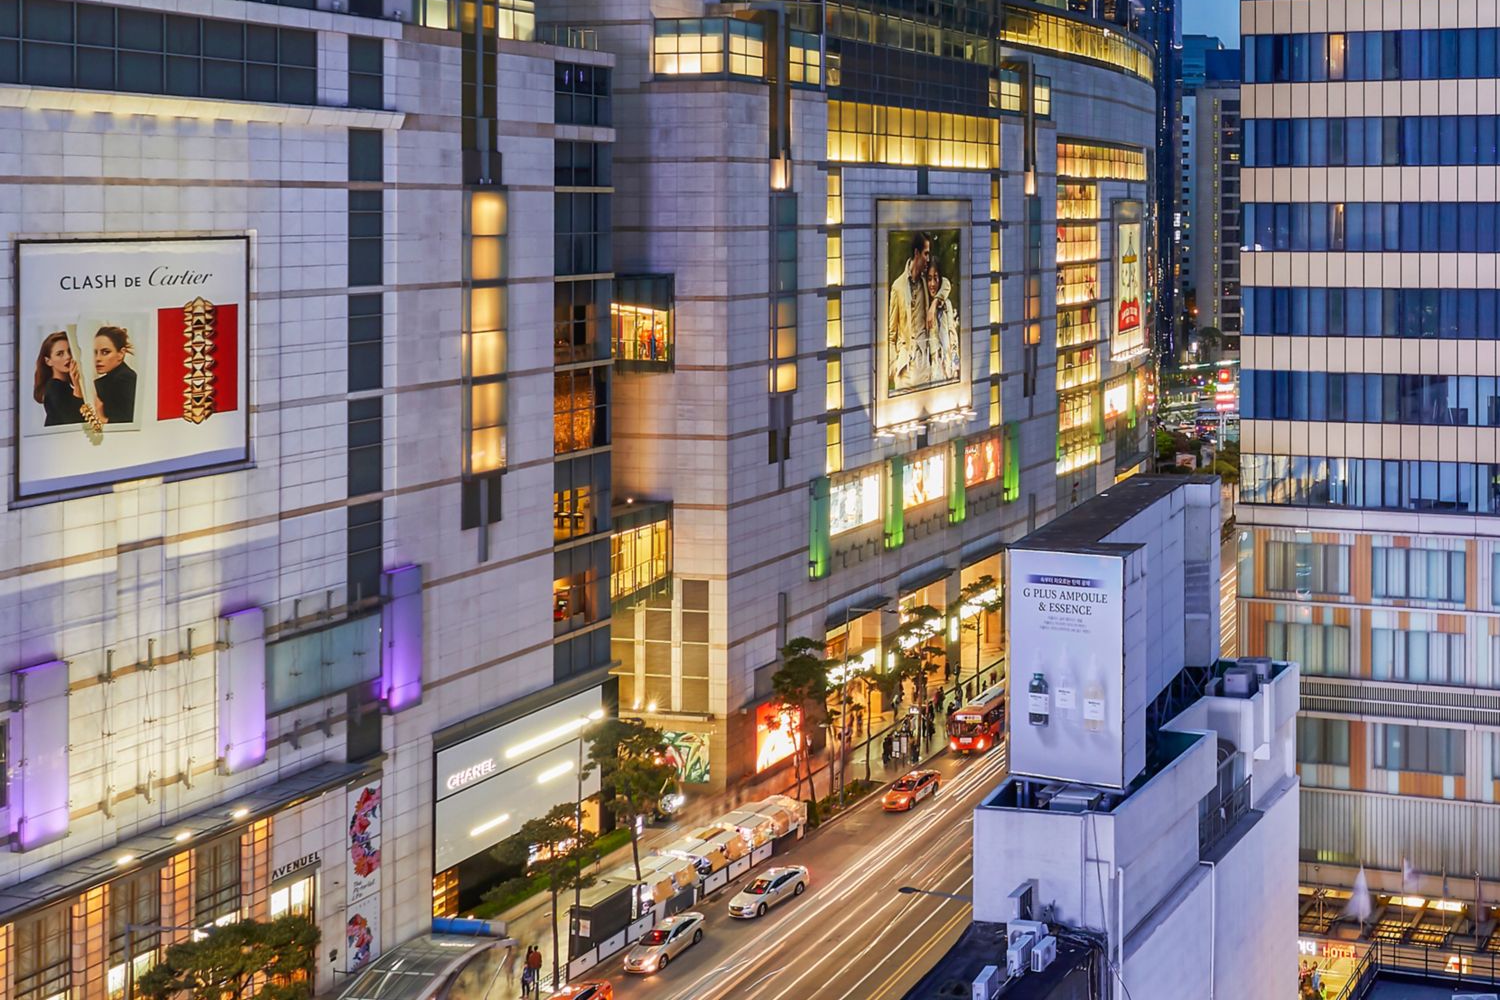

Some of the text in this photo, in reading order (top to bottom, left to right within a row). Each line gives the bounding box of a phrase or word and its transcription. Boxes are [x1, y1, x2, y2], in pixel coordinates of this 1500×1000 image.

[60, 265, 213, 290] CLASH DE Cartier
[1023, 587, 1108, 604] G PLUS AMPOULE
[1038, 601, 1092, 615] & ESSENCE
[272, 851, 320, 880] AVENUEL
[1322, 944, 1358, 960] HOTEL
